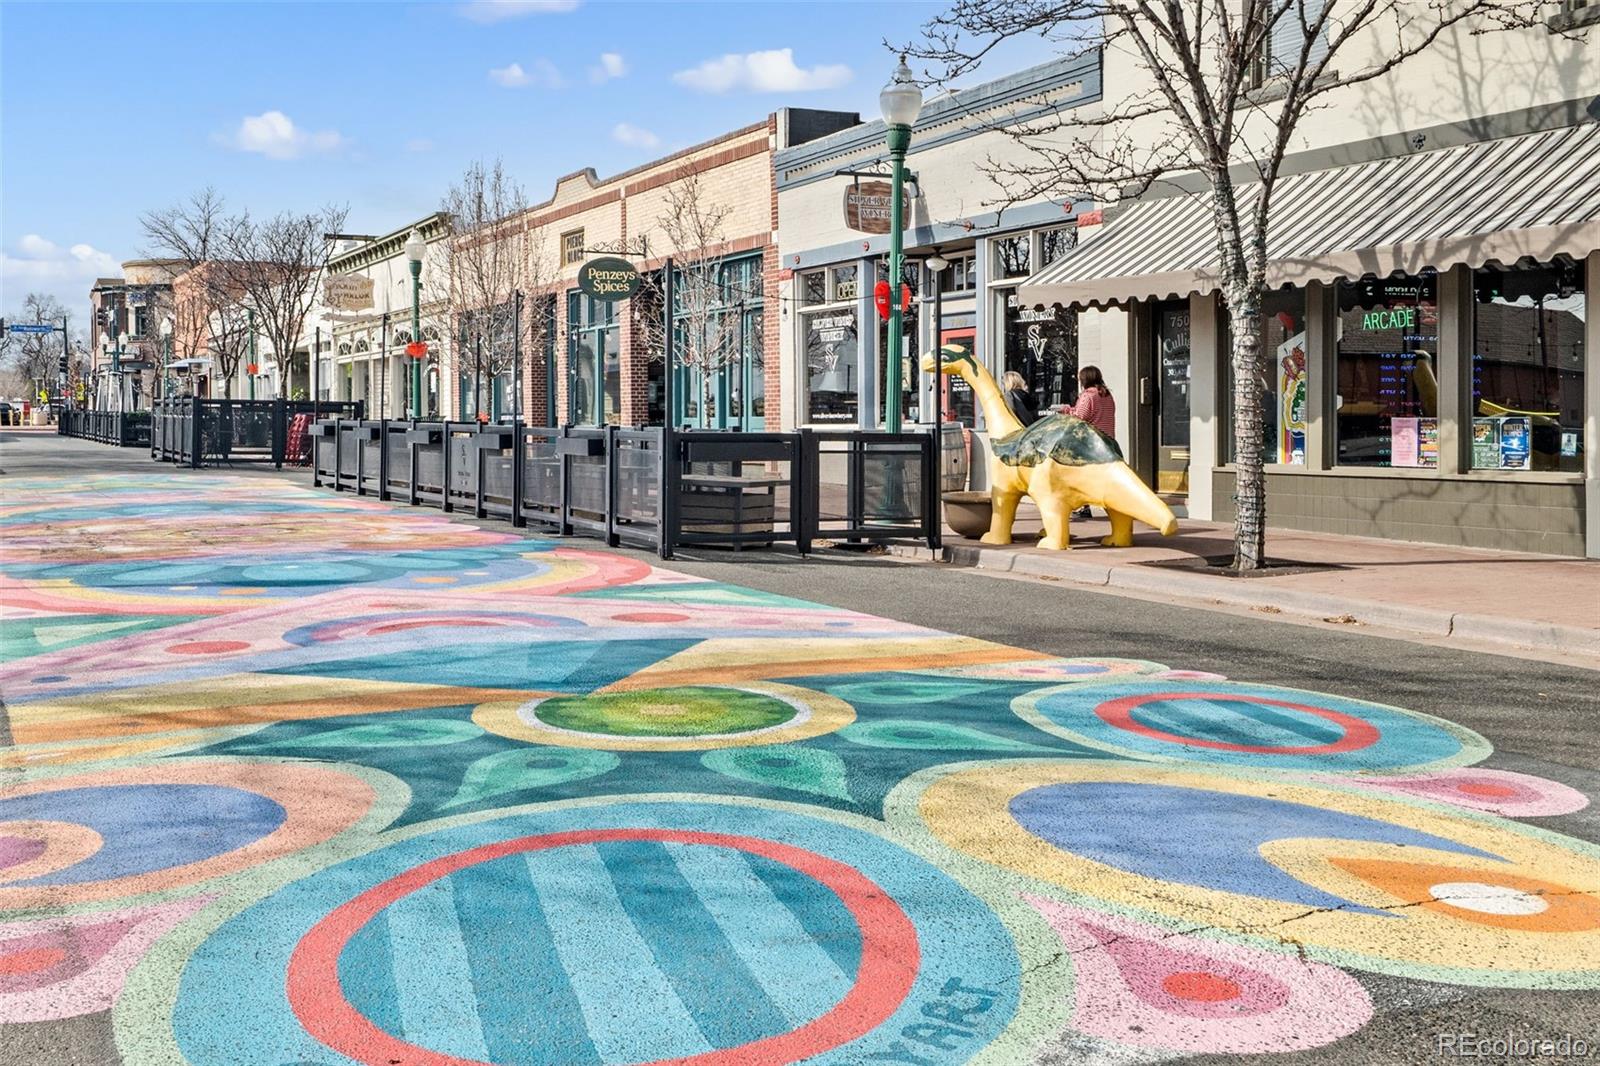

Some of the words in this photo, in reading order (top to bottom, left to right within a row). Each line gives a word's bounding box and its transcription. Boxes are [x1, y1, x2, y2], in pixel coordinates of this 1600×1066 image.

[588, 267, 636, 283] Penzeys
[593, 280, 630, 294] Spices
[1362, 309, 1415, 331] ARCADE
